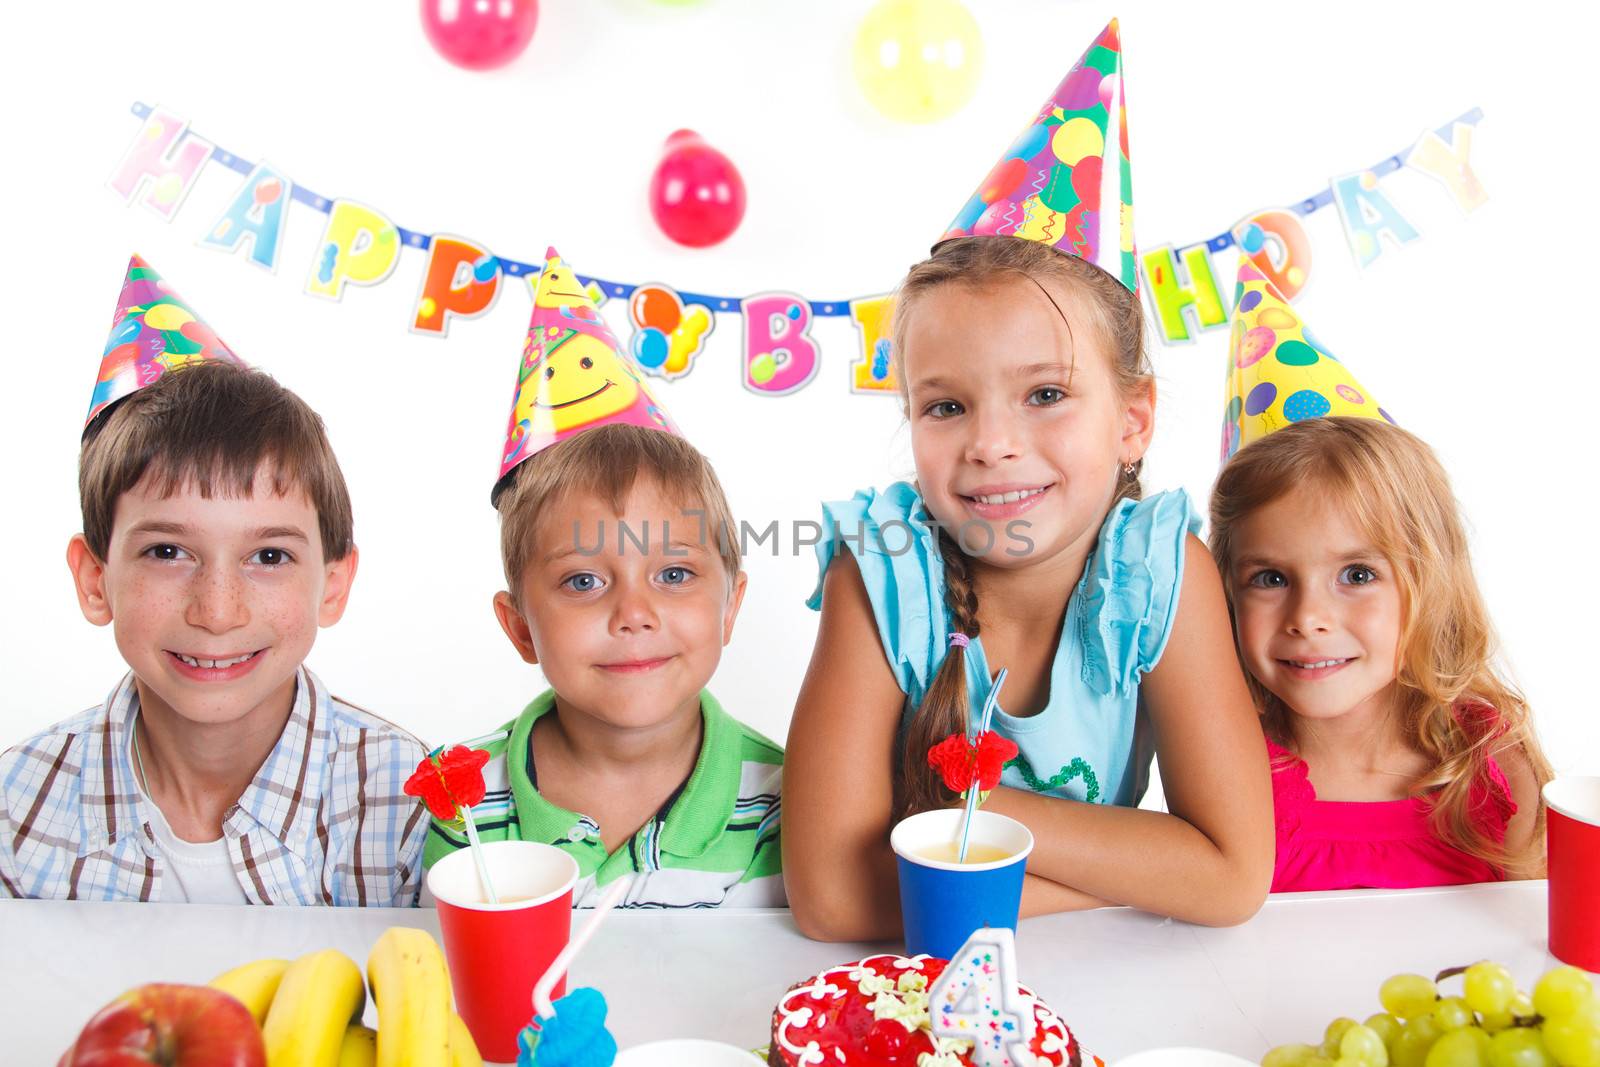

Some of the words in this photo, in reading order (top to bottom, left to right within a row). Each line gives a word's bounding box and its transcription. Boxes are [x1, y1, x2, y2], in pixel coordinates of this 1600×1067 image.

[104, 103, 609, 338] HAPP
[740, 120, 1490, 397] BIHDAY
[928, 927, 1036, 1067] 4
